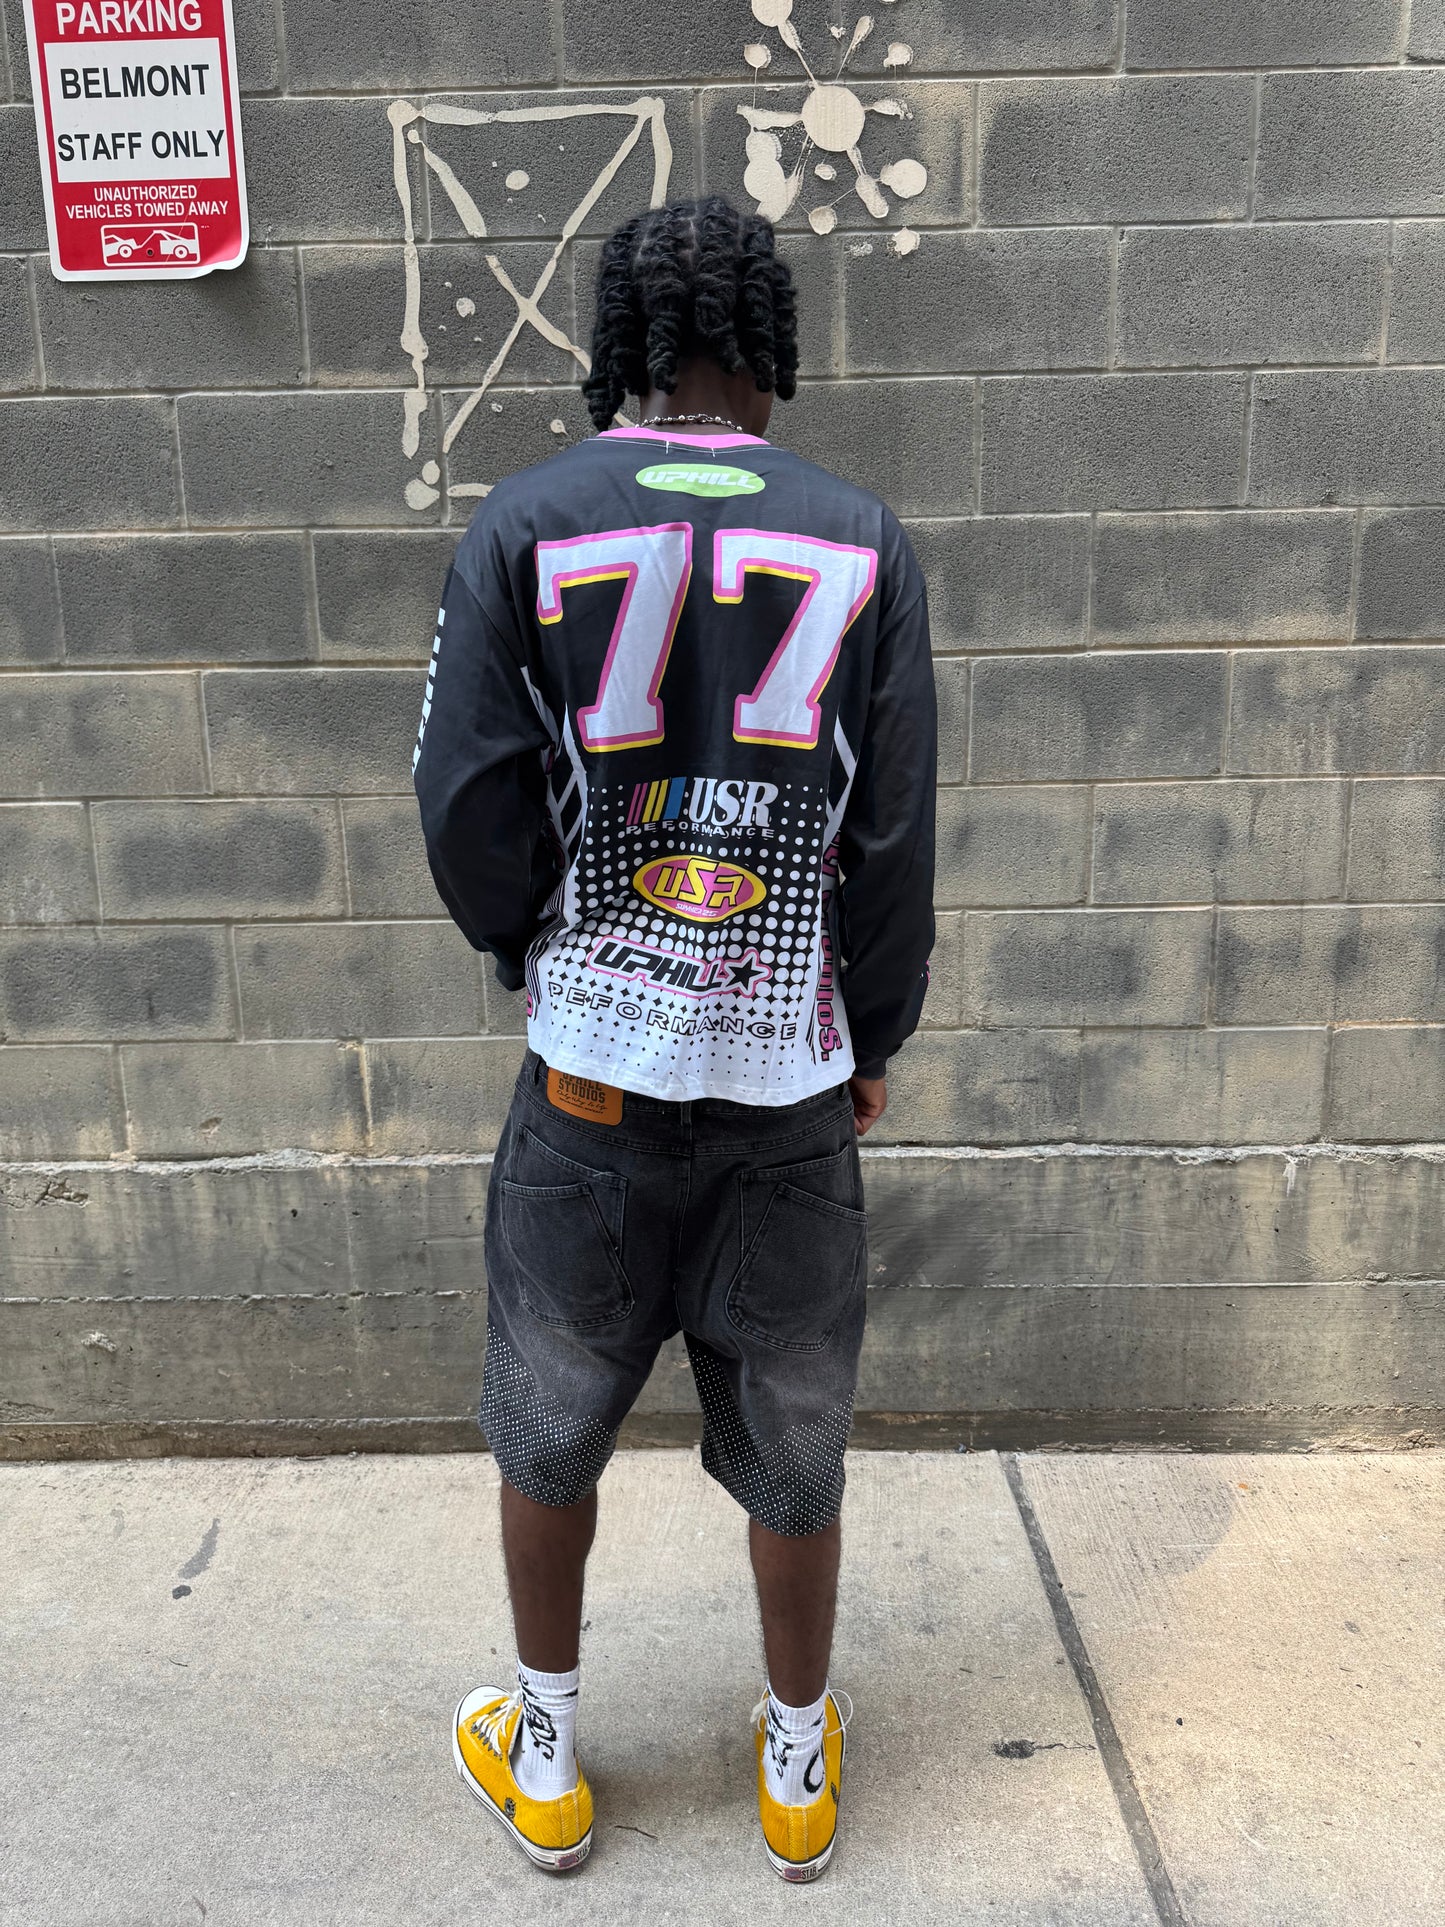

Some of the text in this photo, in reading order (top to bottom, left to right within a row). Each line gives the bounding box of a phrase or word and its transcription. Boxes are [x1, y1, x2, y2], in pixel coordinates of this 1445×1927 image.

[56, 0, 203, 35] PARKING
[60, 64, 210, 99] BELMONT
[57, 129, 225, 162] STAFF ONLY
[65, 200, 229, 219] VEHICLES TOWED AWAY
[94, 185, 197, 202] UNAUTHORIZED
[642, 471, 756, 489] UPHILL
[533, 522, 878, 753] 77
[688, 776, 779, 828] USR
[626, 820, 775, 838] PEFORMANCE
[593, 941, 722, 992] UPHILL
[816, 889, 843, 1061] UDIOS.
[548, 982, 797, 1040] PEFORMANCE
[558, 1078, 606, 1104] STUDIOS
[801, 1866, 817, 1880] STAR
